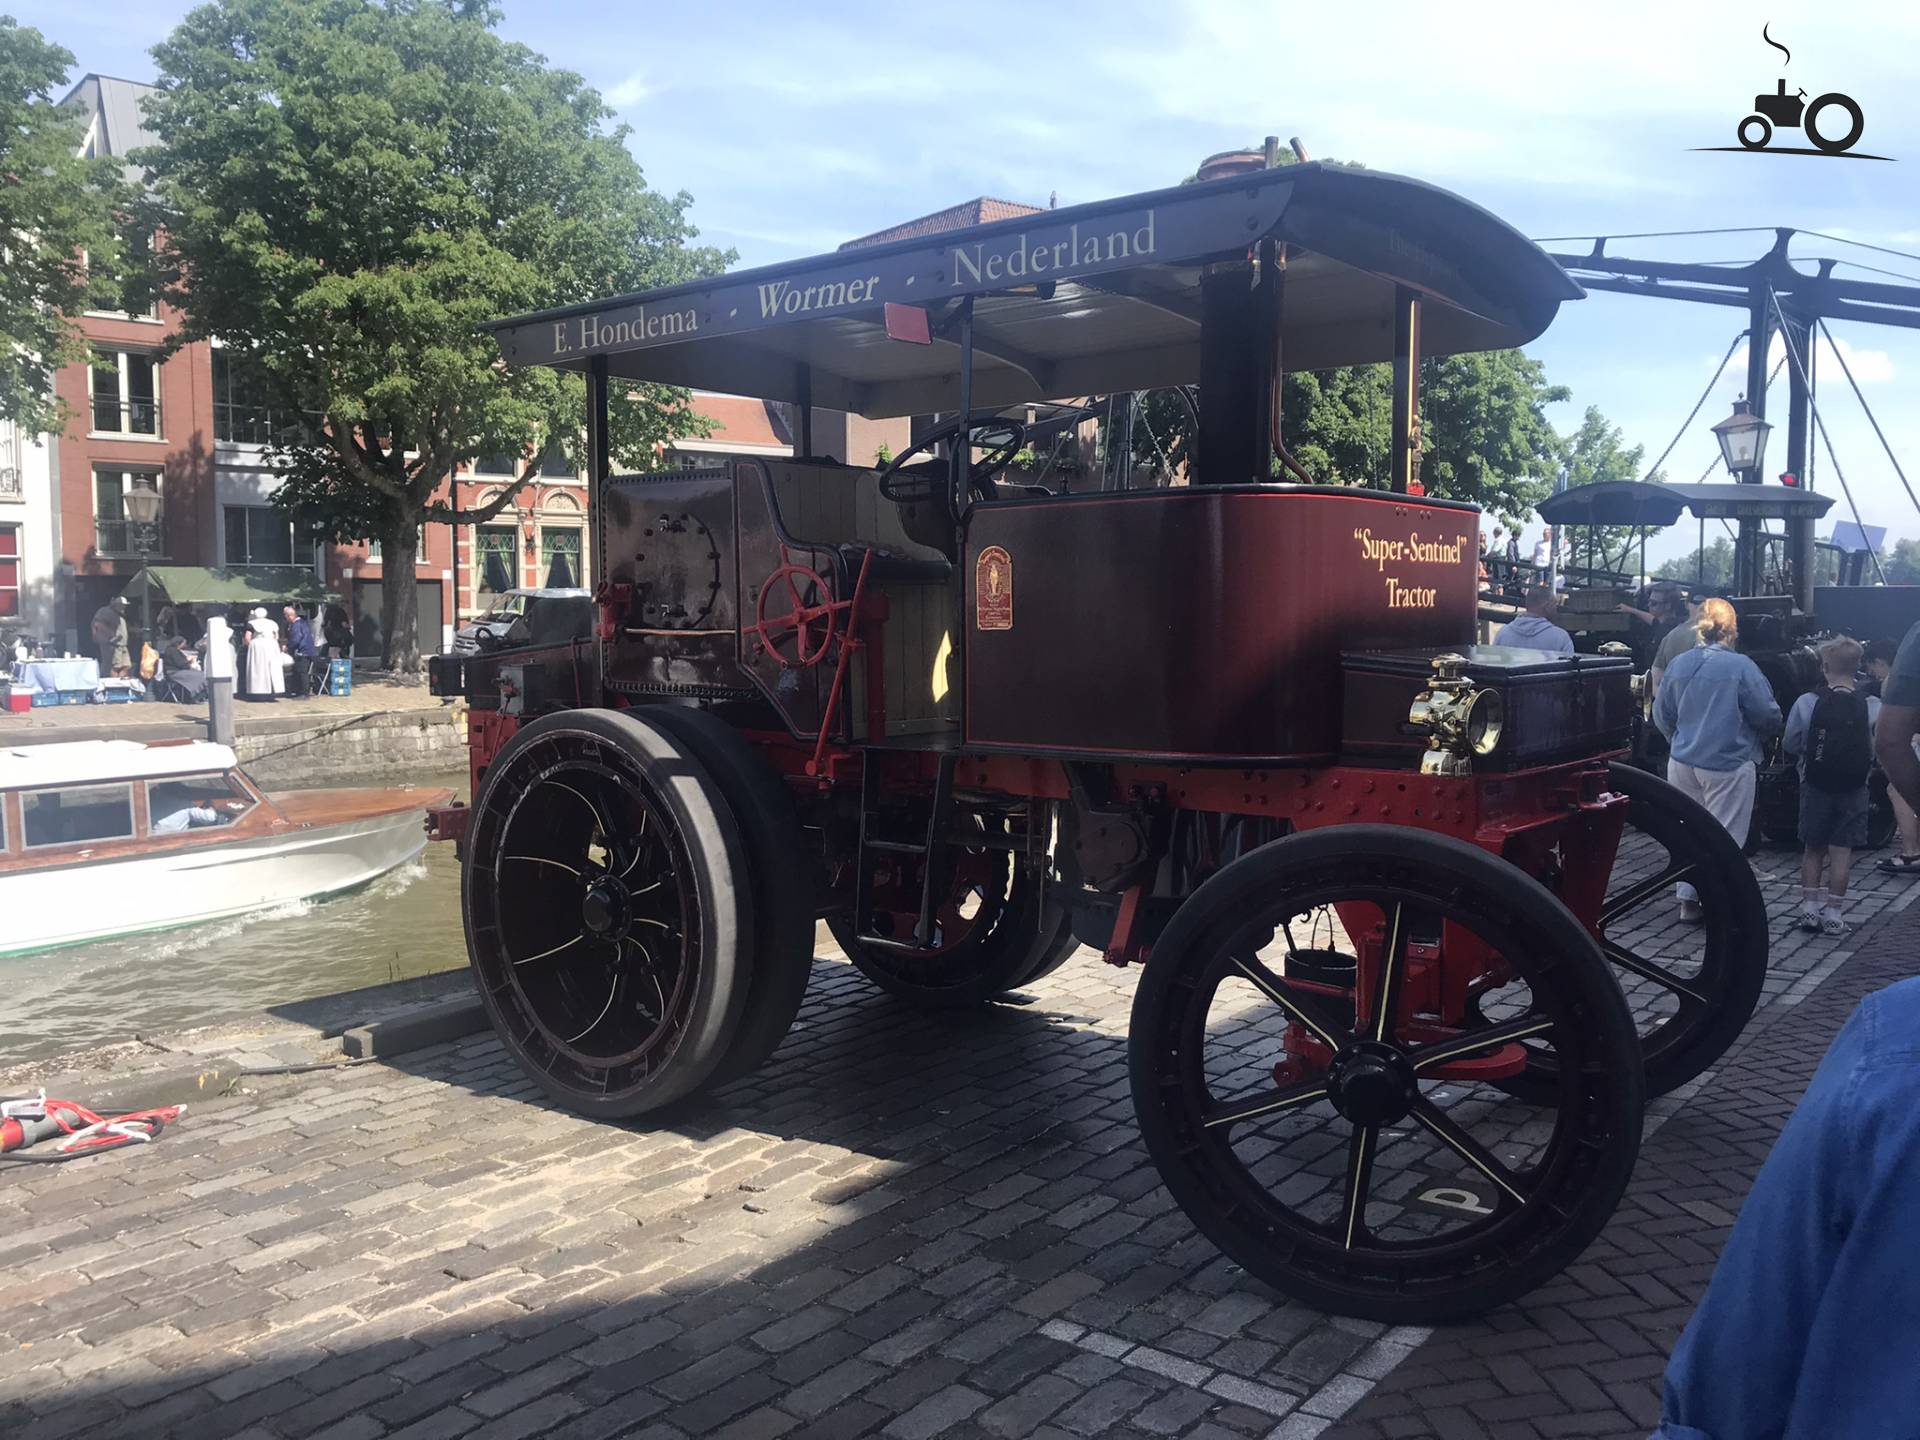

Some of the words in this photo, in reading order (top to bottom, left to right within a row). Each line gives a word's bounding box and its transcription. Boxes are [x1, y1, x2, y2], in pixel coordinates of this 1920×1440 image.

[552, 322, 572, 354] E.
[579, 306, 699, 349] Hondema
[758, 275, 880, 319] Wormer
[951, 209, 1157, 287] Nederland
[1385, 577, 1437, 609] Tractor
